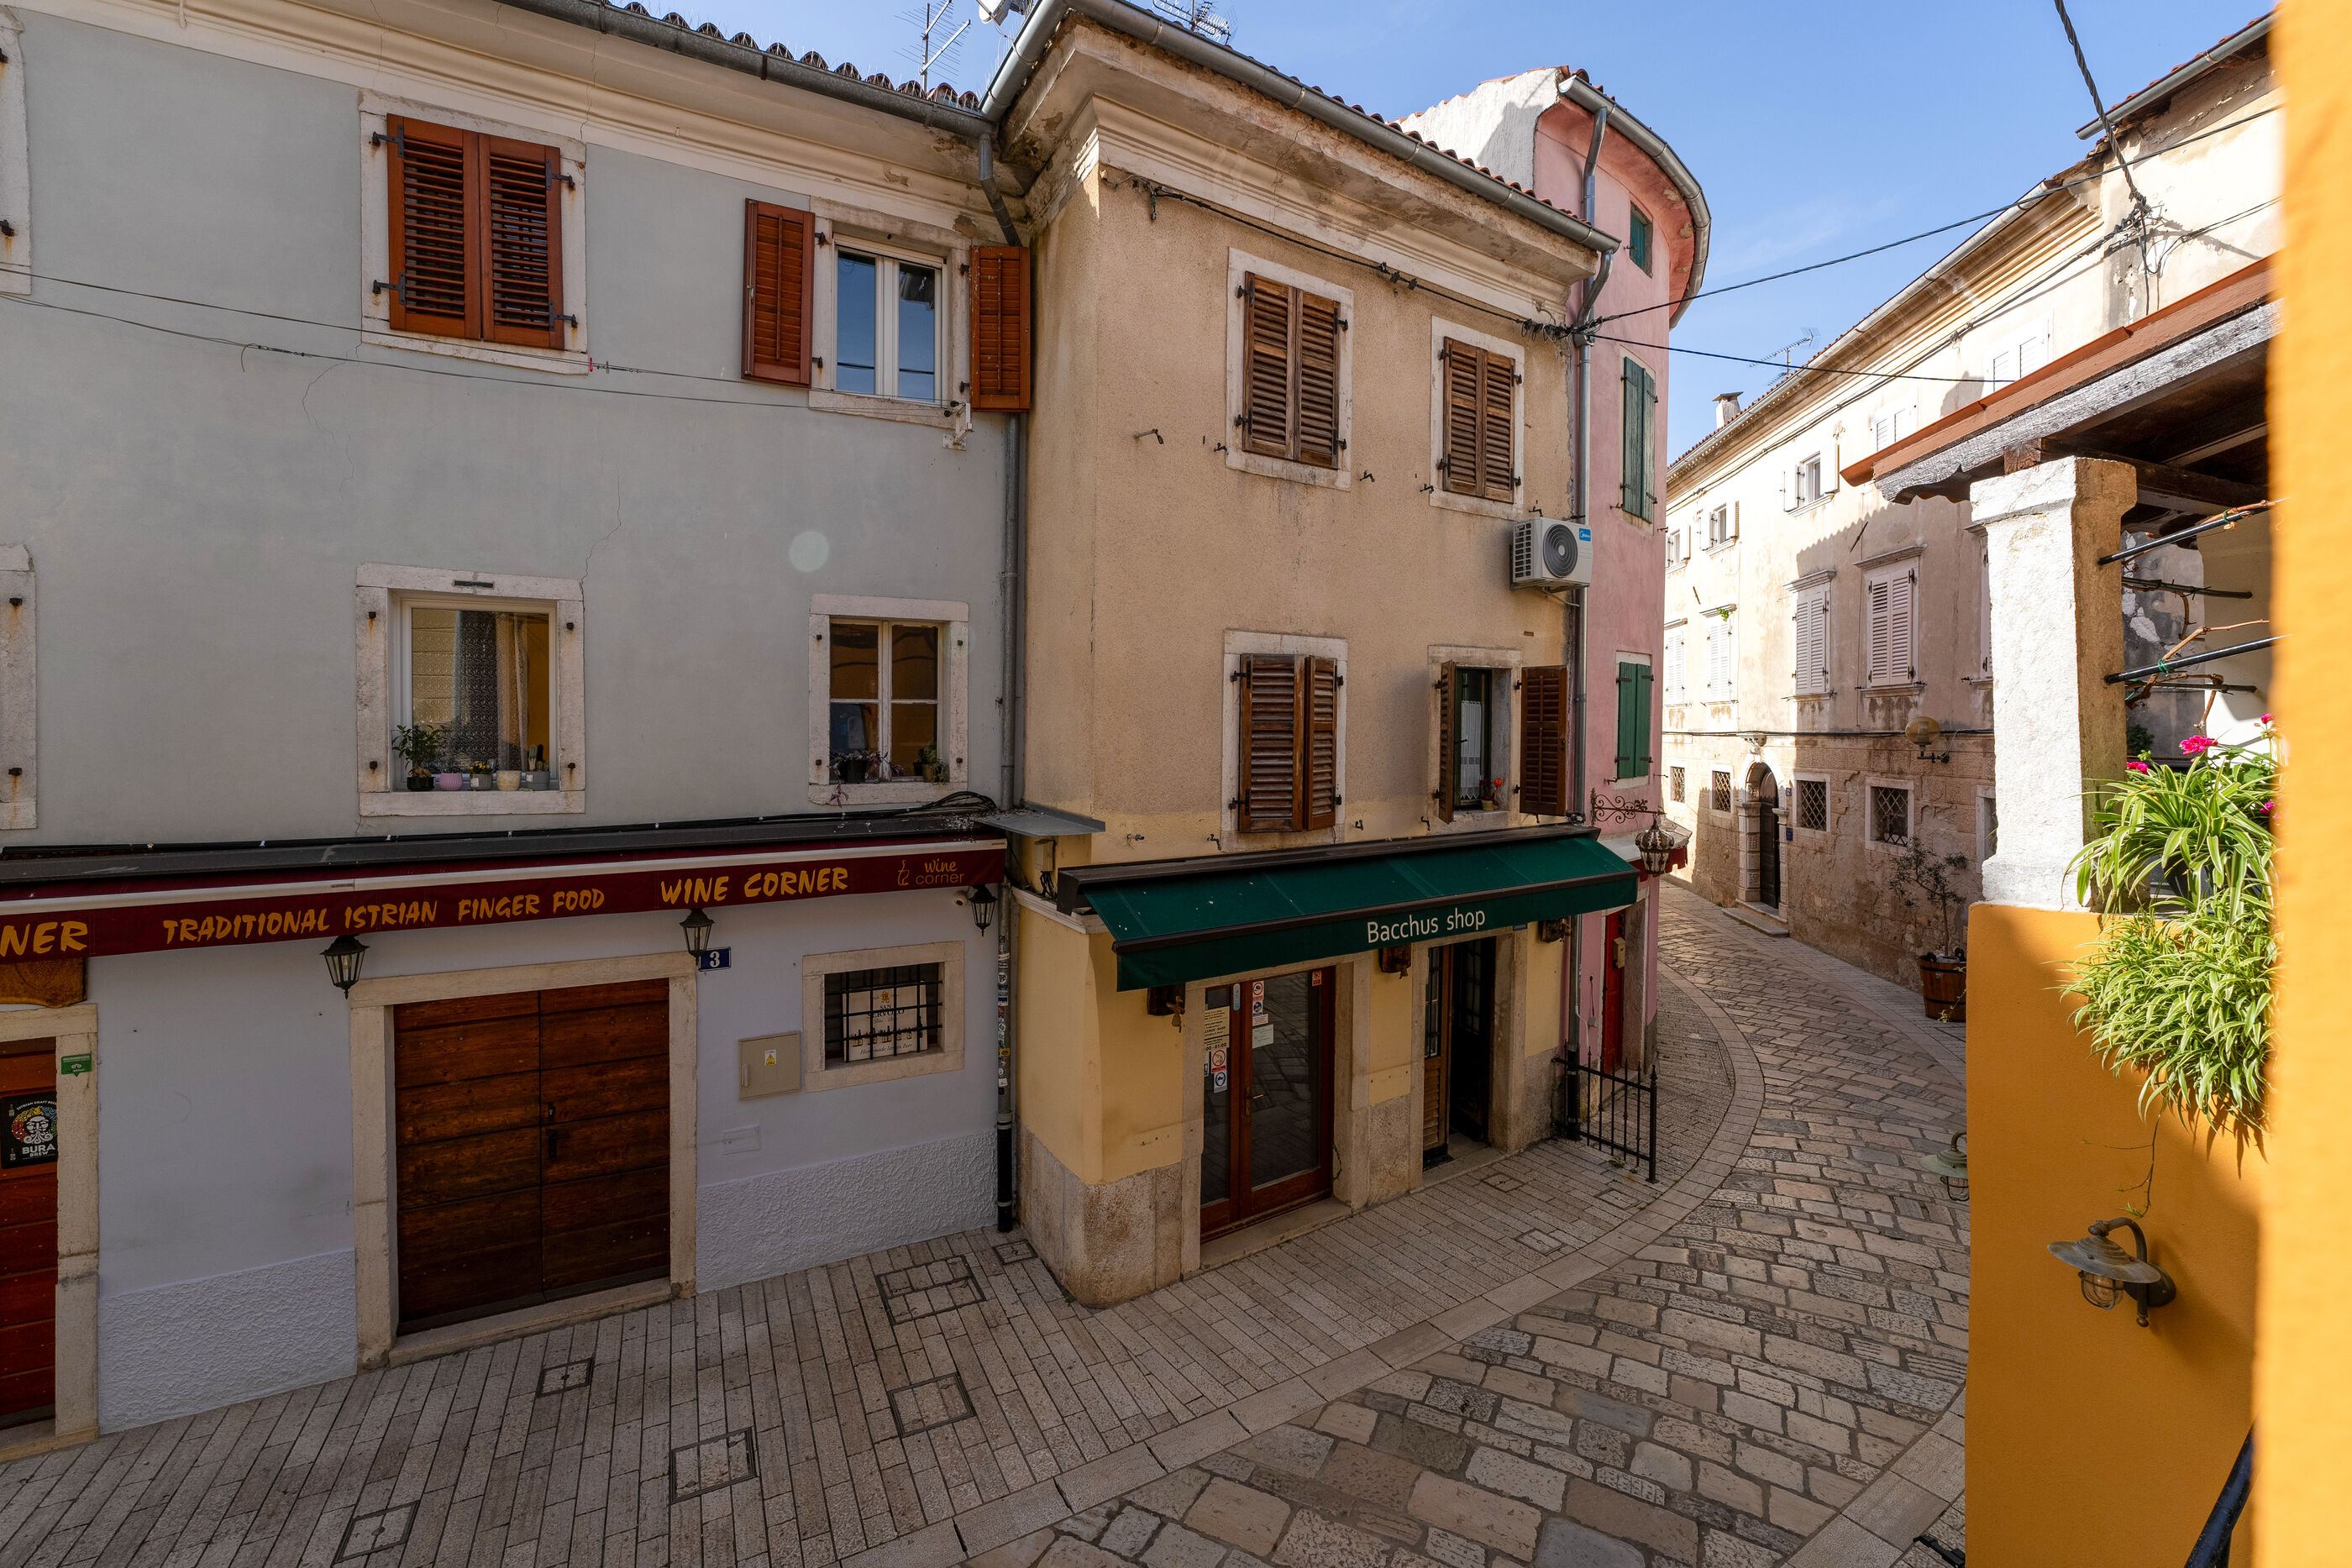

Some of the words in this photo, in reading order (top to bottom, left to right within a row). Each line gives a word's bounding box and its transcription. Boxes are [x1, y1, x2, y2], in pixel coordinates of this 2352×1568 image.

[915, 873, 965, 885] corner
[924, 858, 958, 873] wine
[660, 877, 729, 905] WINE
[744, 867, 848, 898] CORNER
[163, 909, 330, 944] TRADITIONAL
[344, 900, 438, 929] ISTRIAN
[458, 894, 540, 920] FINGER
[553, 889, 605, 914] FOOD
[1367, 915, 1439, 944] Bacchus
[1446, 907, 1486, 931] shop
[0, 920, 88, 957] NER
[709, 951, 721, 968] 3
[22, 1143, 56, 1155] BURA
